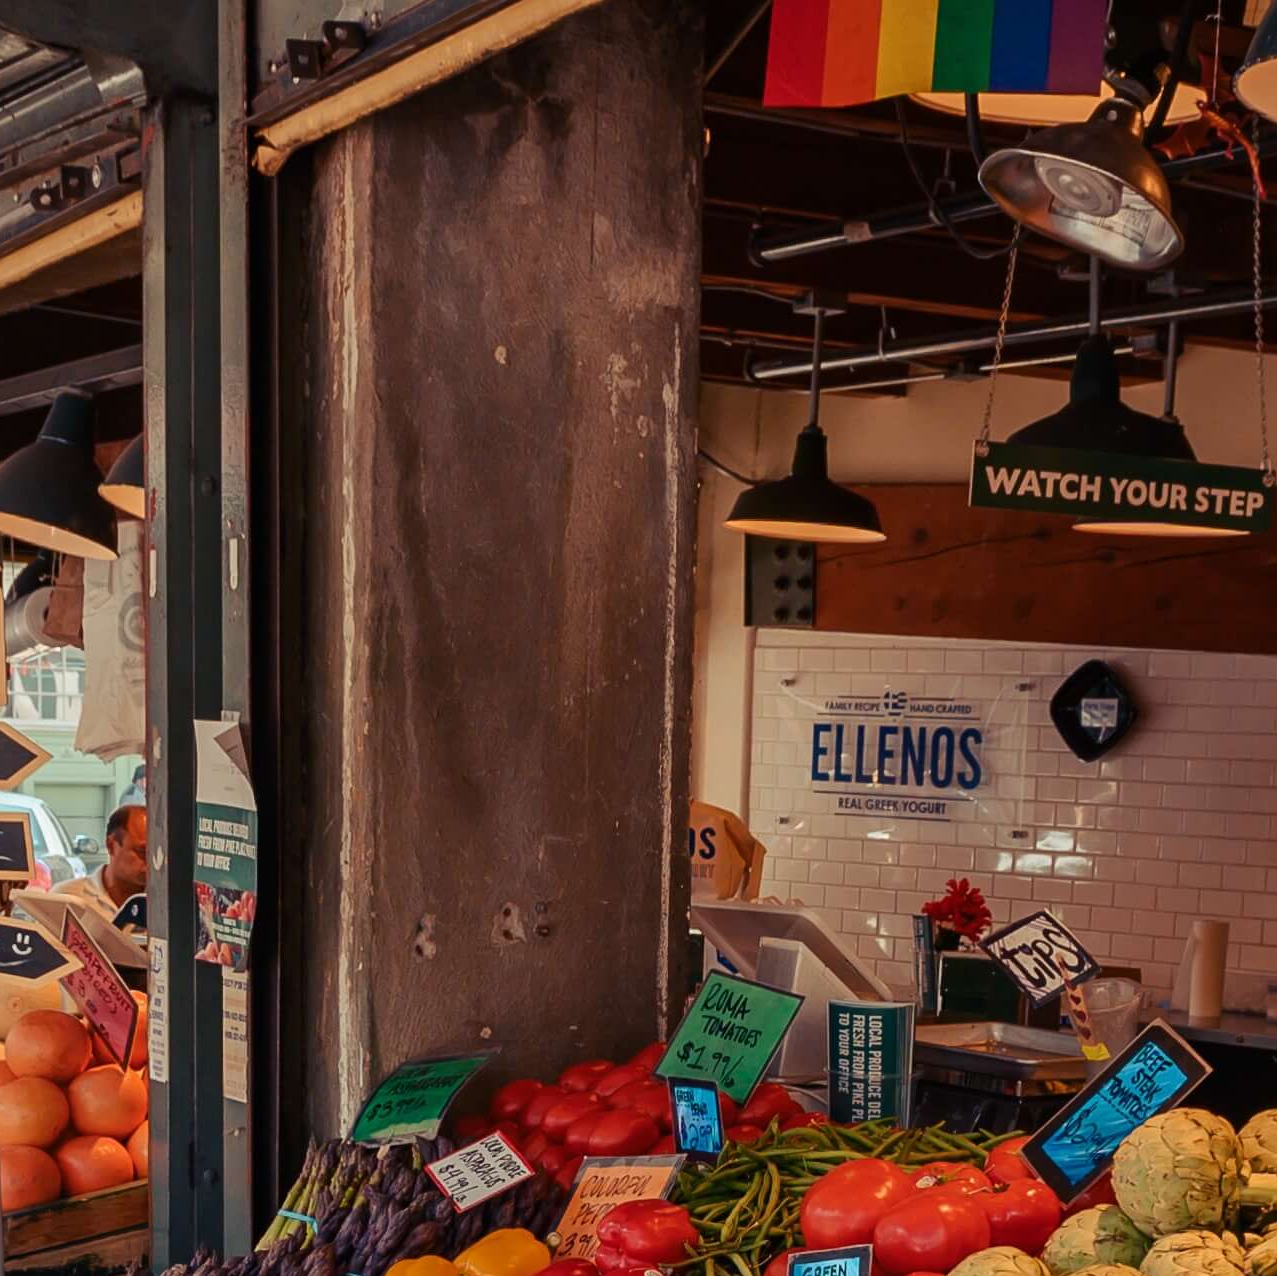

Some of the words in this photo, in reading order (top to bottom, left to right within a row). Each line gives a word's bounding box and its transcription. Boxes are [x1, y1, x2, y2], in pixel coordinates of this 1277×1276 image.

[985, 465, 1102, 503] WATCH
[1109, 477, 1188, 511] YOUR
[1194, 486, 1265, 517] STEP
[854, 702, 881, 712] RECIPE
[910, 703, 934, 713] HAND
[936, 704, 972, 714] CRAFTED
[811, 723, 983, 790] ELLENOS
[838, 797, 862, 810] REAL
[865, 798, 899, 812] GREEK
[902, 800, 947, 815] YOGURT
[700, 981, 752, 1022] ROMA
[700, 1014, 763, 1049] TOMATOES
[838, 1012, 850, 1026] TO
[852, 1014, 866, 1046] FRESH
[868, 1015, 883, 1048] LOCAL
[837, 1028, 850, 1056] YOUR
[837, 1057, 850, 1095] OFFICE
[851, 1048, 865, 1081] FROM
[867, 1050, 883, 1098] PRODUCE
[1134, 1044, 1173, 1077] BEEF
[851, 1082, 865, 1107] PIKE
[1131, 1068, 1163, 1102] STEAK
[579, 1174, 653, 1200] COLORFUL
